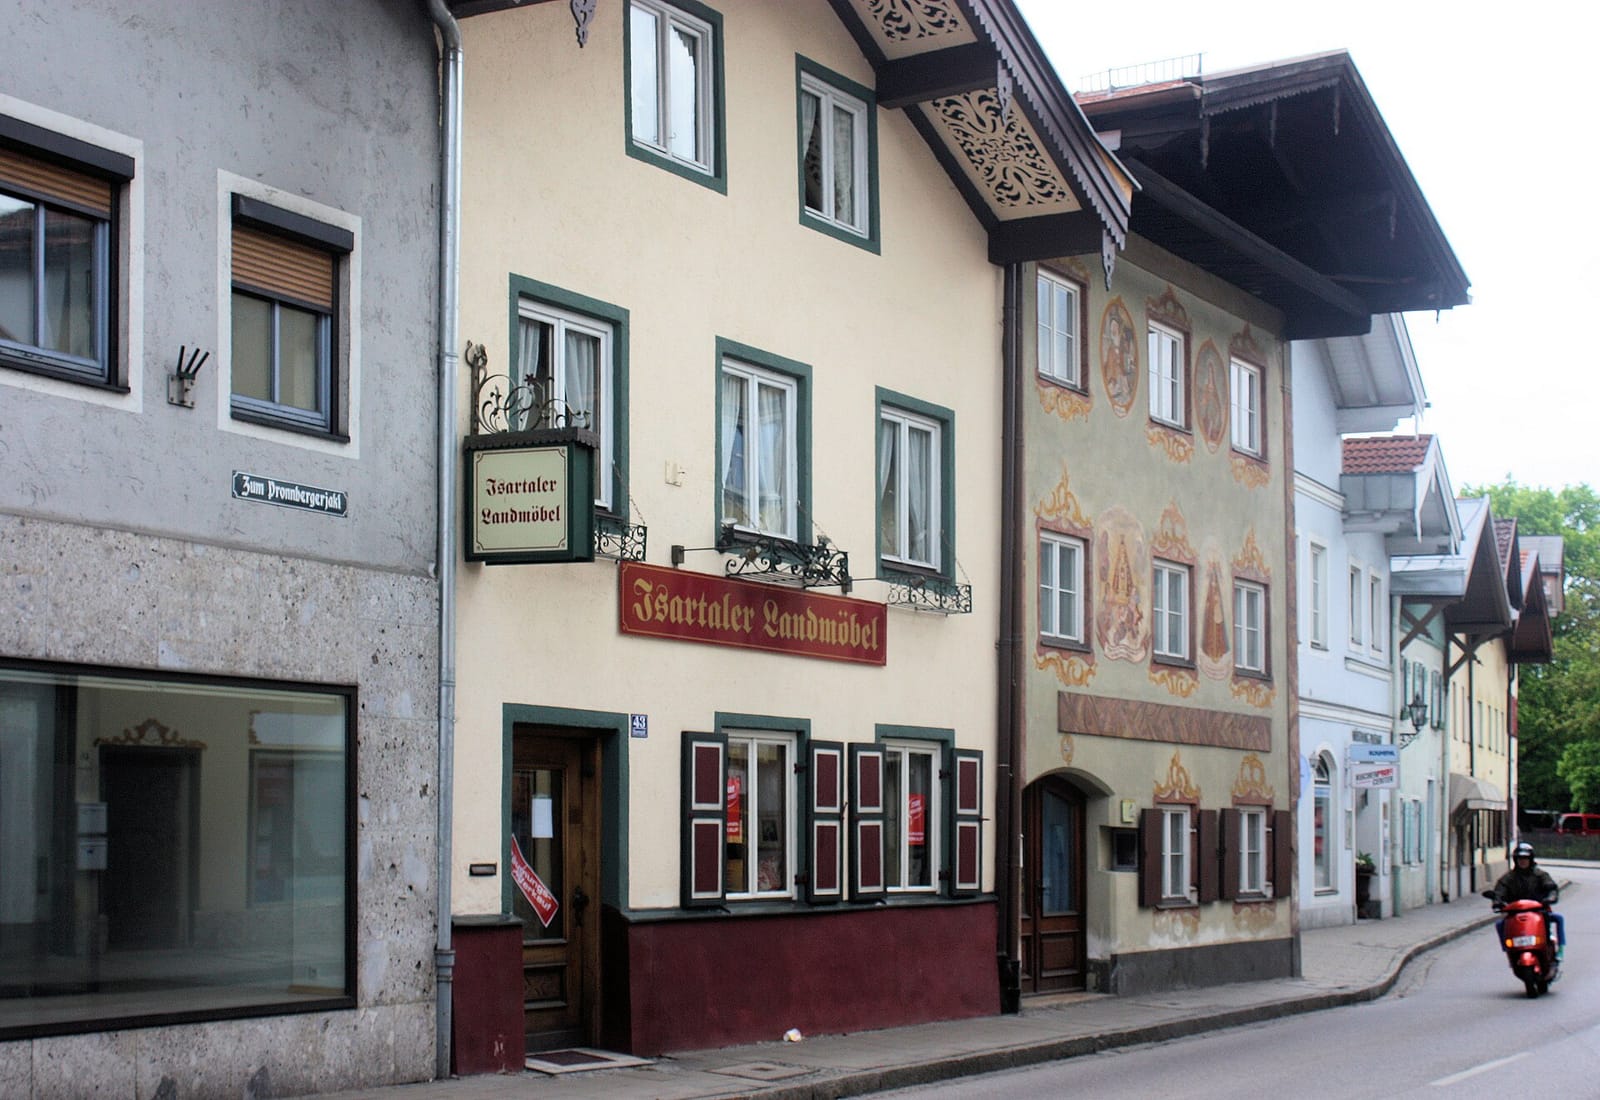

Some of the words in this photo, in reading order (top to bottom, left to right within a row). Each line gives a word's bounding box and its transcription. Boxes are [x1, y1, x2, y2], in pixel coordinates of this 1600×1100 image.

[241, 475, 265, 496] Zum
[486, 475, 557, 497] Isartaler
[481, 505, 561, 525] Landmöbel
[633, 578, 756, 634] Isartaler
[762, 599, 879, 651] Landmöbel
[632, 715, 647, 729] 43
